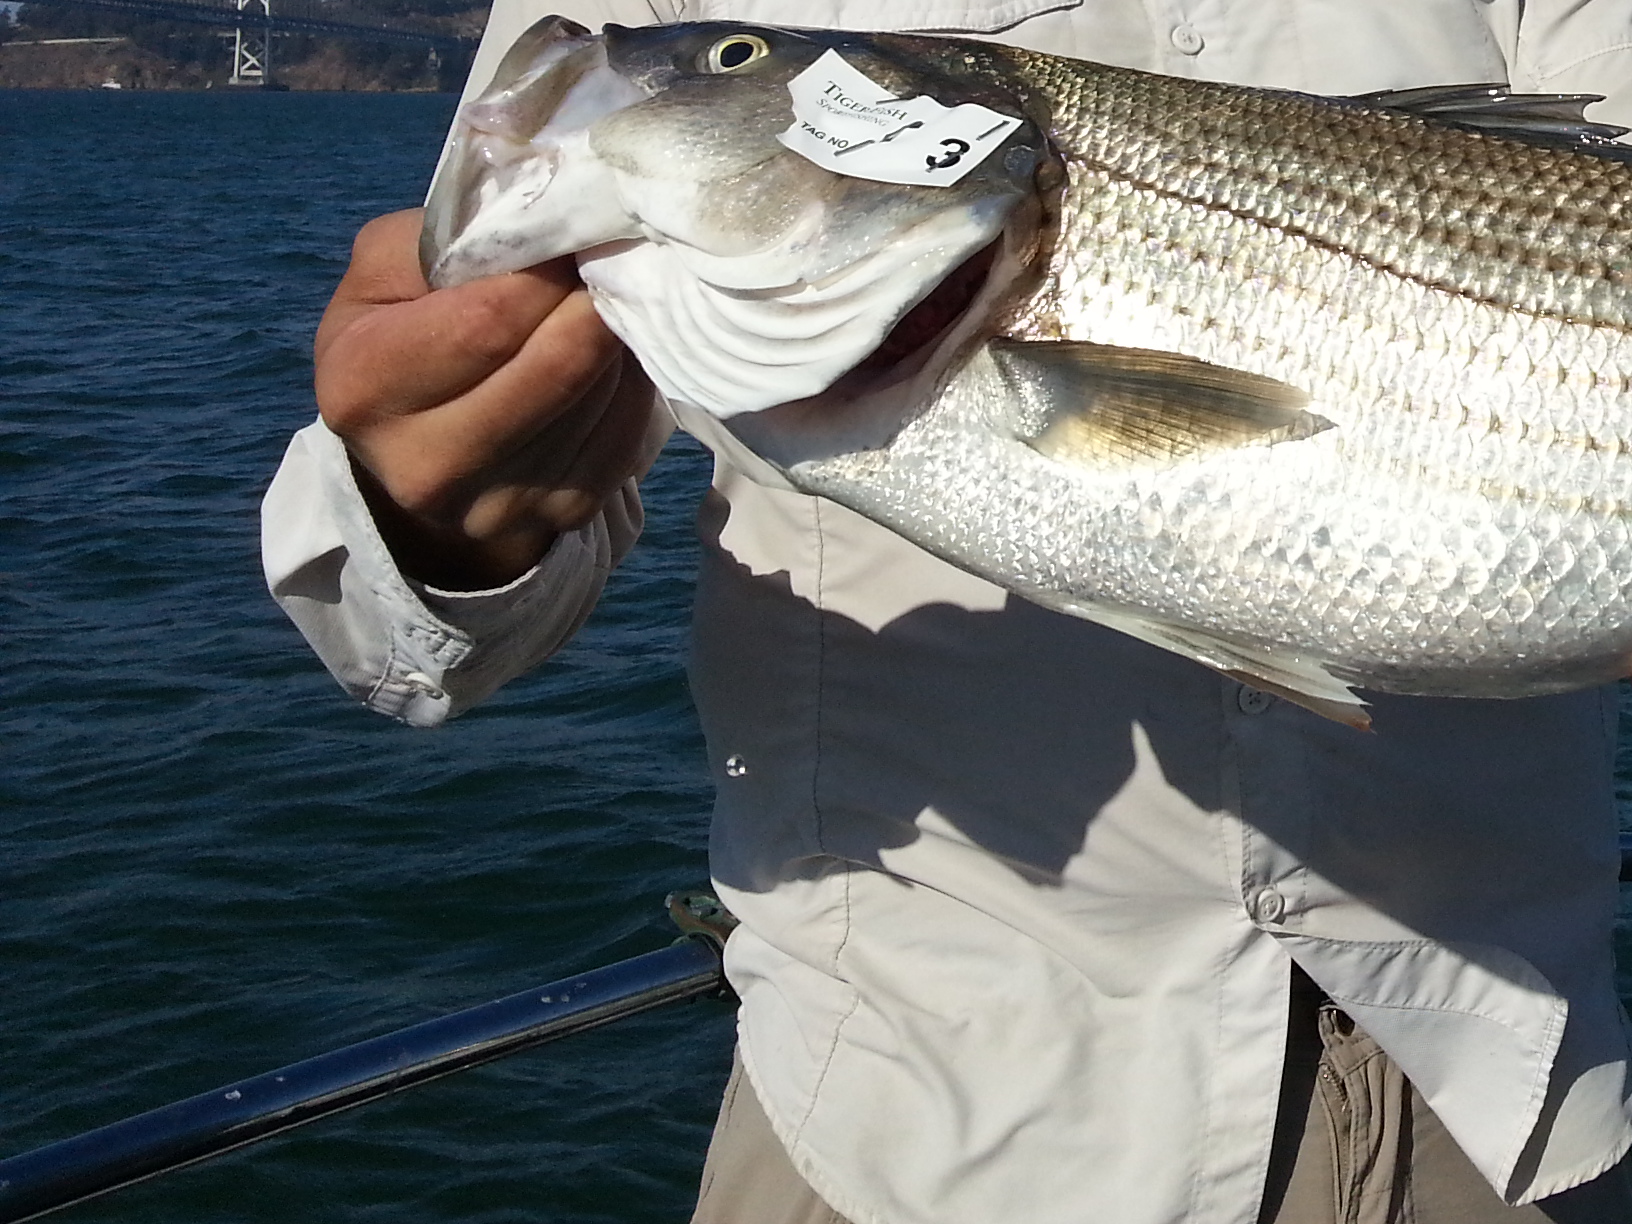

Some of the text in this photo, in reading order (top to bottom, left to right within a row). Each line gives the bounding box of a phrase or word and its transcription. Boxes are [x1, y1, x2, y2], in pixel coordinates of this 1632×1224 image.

[800, 120, 850, 149] TAG NO
[926, 137, 971, 169] 3
